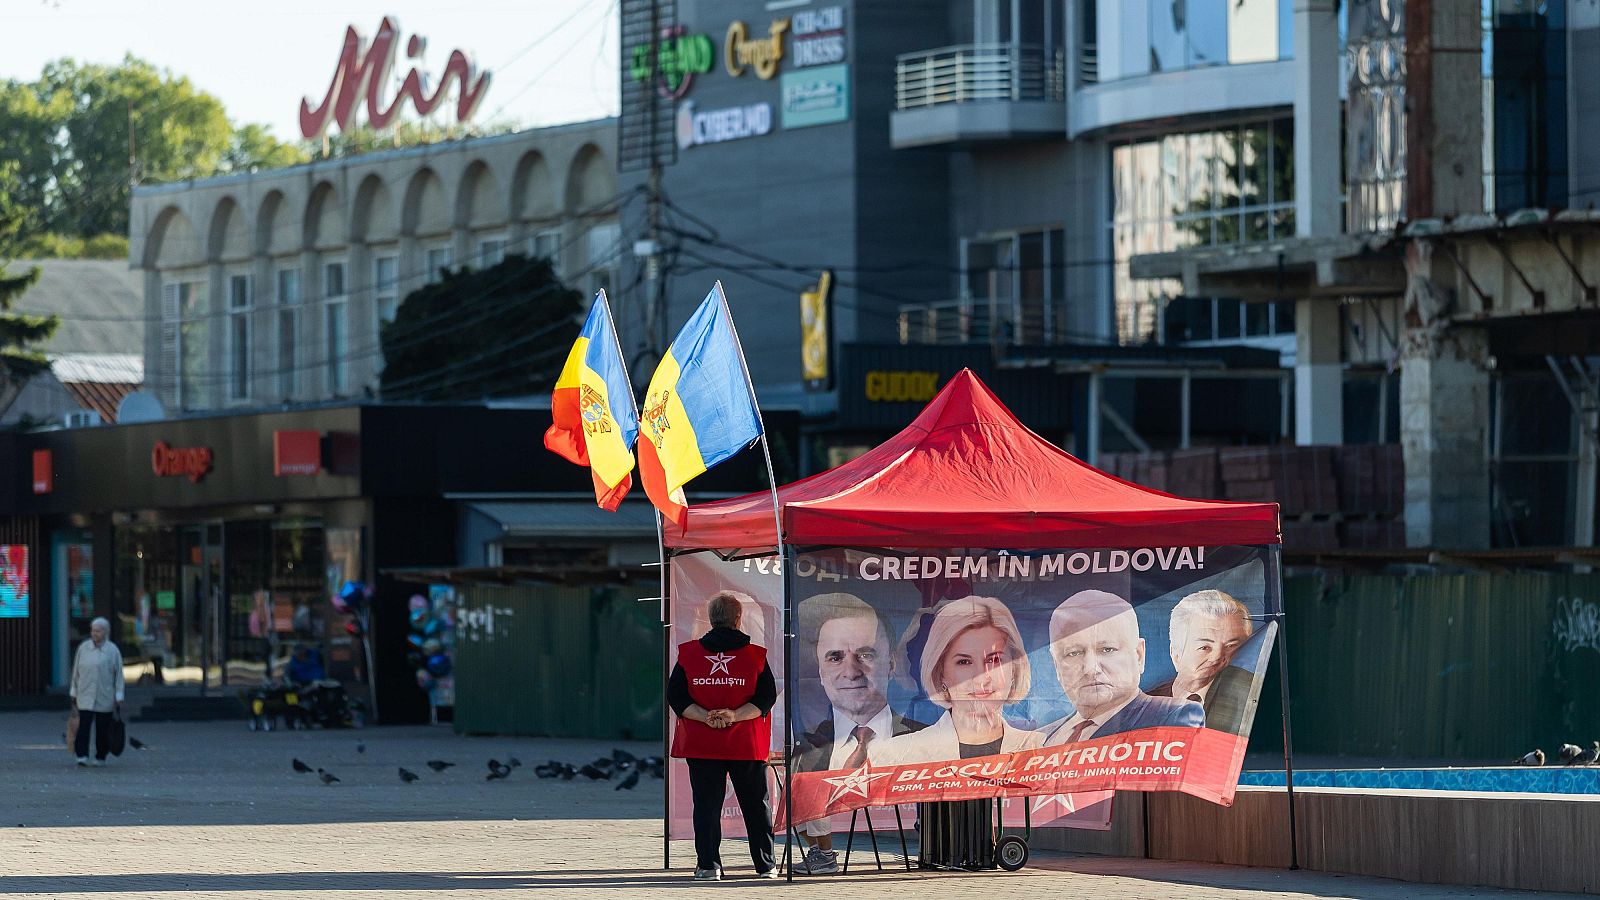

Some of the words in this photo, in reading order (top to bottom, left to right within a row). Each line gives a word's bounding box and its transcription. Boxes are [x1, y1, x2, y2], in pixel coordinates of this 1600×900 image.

[299, 16, 491, 140] Mir
[865, 371, 940, 402] GUDOK
[151, 441, 210, 482] Orange
[859, 556, 985, 581] CREDEM
[997, 549, 1031, 578] ÎN
[1038, 545, 1205, 577] MOLDOVA!
[891, 783, 925, 792] PSRM,
[928, 780, 962, 790] PCRM,
[1019, 770, 1081, 783] MOLDOVEI,
[1083, 767, 1117, 777] INIMA
[1119, 766, 1181, 775] MOLDOVEI
[896, 760, 1016, 782] BLOCUL
[1024, 741, 1186, 771] PATRIOTIC
